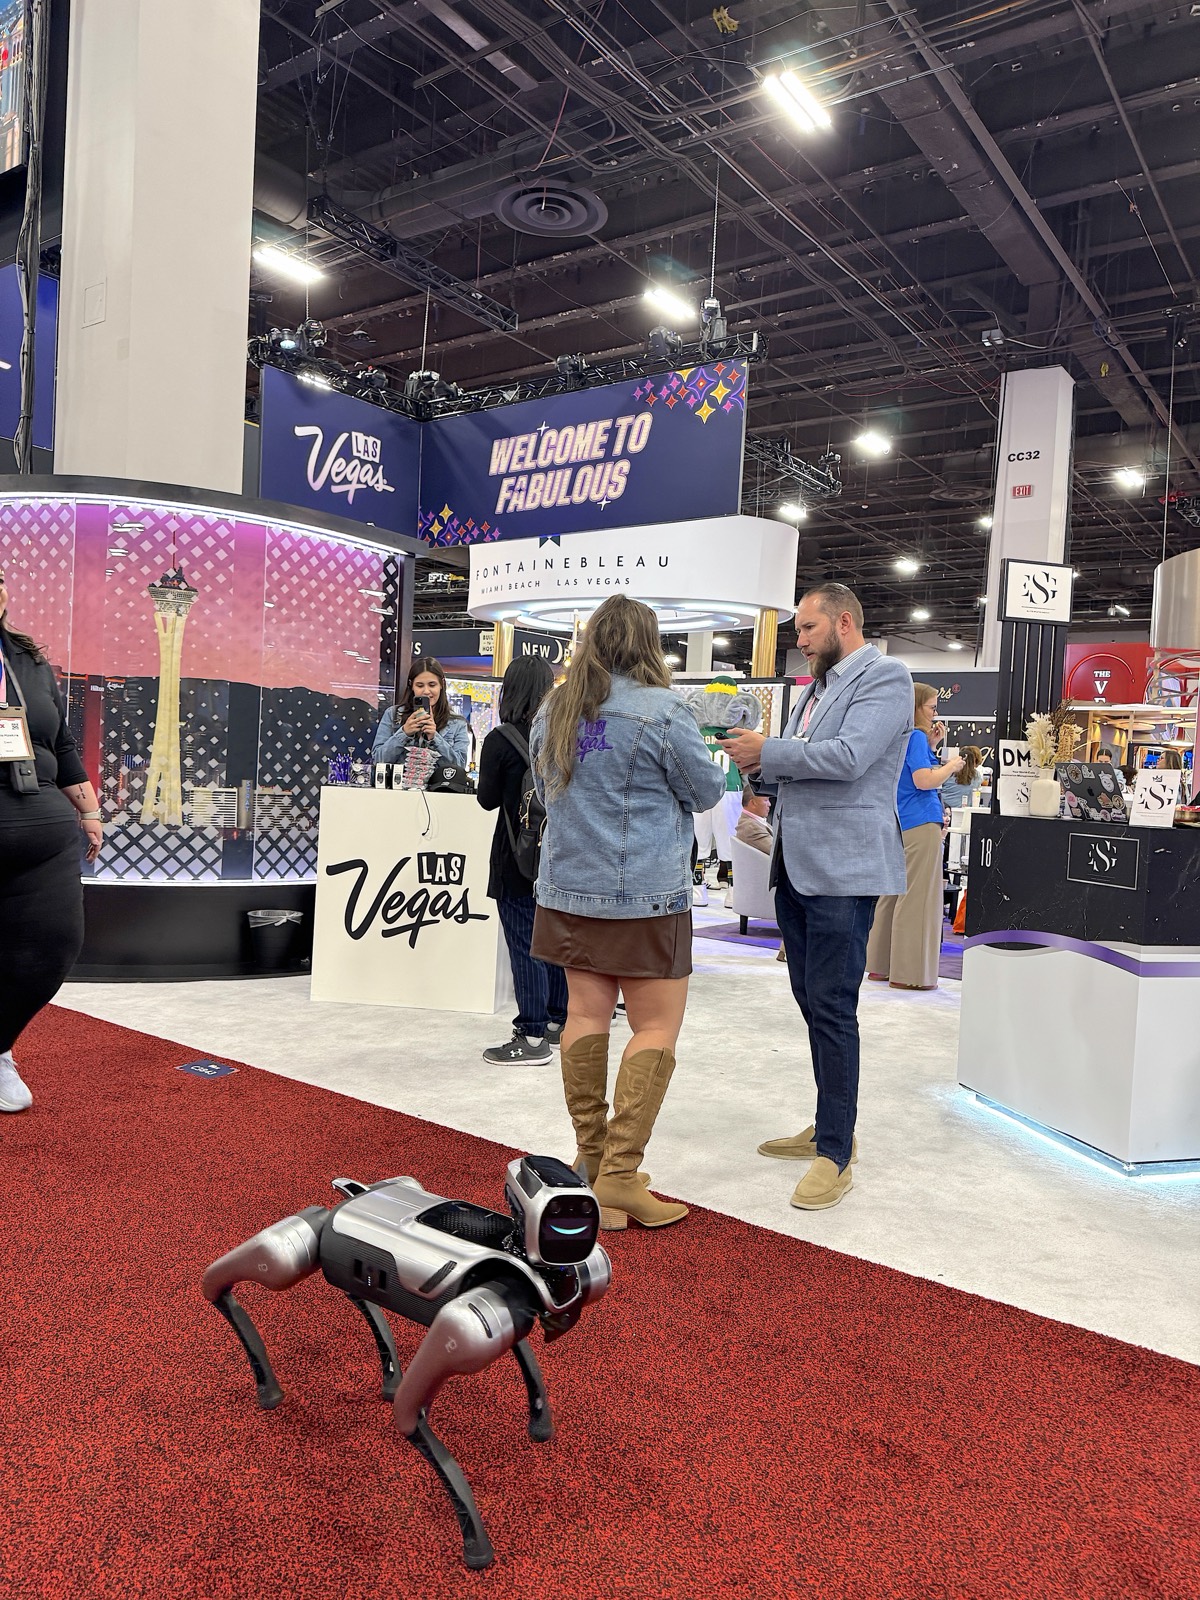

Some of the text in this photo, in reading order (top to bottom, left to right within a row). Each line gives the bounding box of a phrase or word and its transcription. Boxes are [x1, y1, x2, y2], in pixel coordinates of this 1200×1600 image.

[353, 433, 380, 461] LAS
[489, 411, 654, 476] WELCOME TO
[1007, 450, 1040, 462] CC32
[294, 425, 395, 505] Vegas
[494, 458, 631, 515] FABULOUS
[1015, 486, 1030, 496] EXIT
[475, 555, 669, 581] FONTAINEBLEAU
[481, 577, 631, 594] MIAMI BEACH LAS VEGAS
[522, 641, 551, 659] NEW
[1093, 670, 1111, 678] THE
[585, 721, 606, 735] LAS
[1003, 748, 1041, 768] DM
[980, 838, 993, 868] 18
[420, 854, 464, 883] LAS
[325, 856, 490, 949] Vegas
